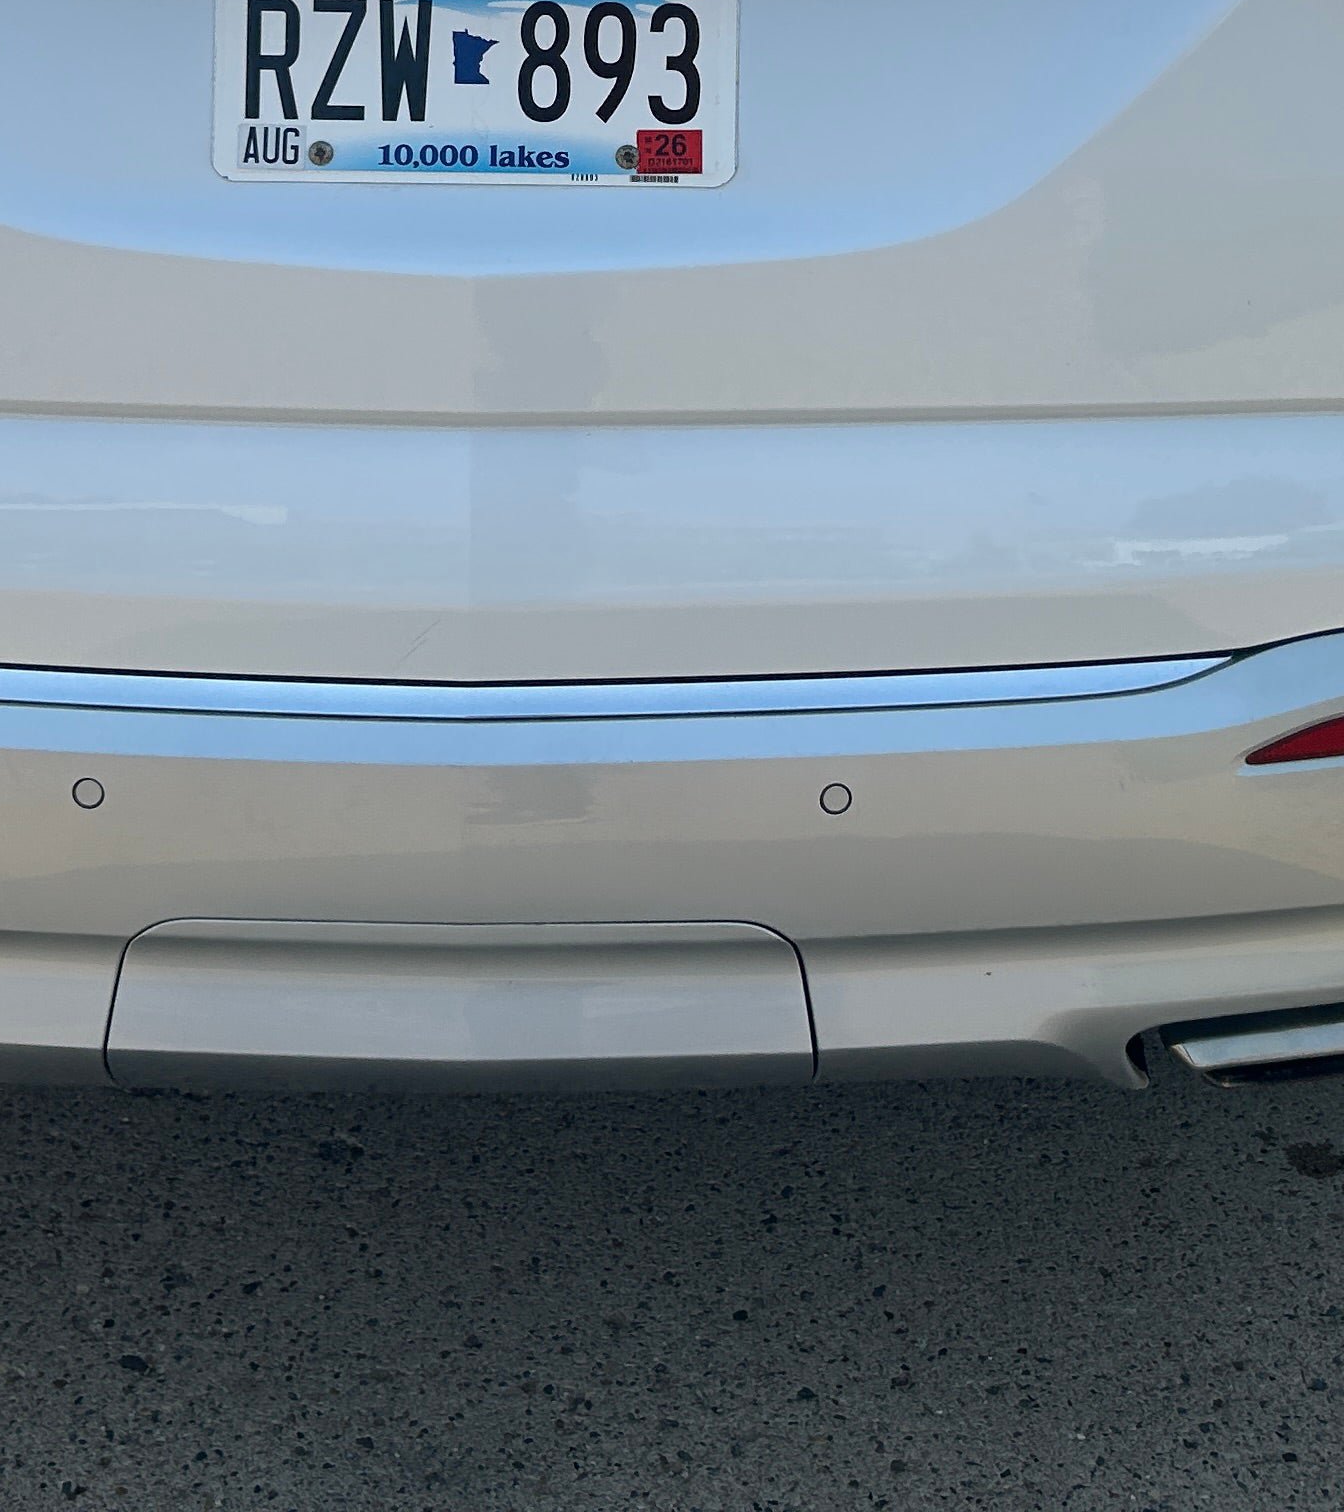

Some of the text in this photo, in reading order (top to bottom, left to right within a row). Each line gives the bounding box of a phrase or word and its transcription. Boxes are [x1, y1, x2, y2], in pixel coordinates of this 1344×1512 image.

[517, 0, 701, 125] 893
[243, 126, 300, 165] AUG
[377, 144, 570, 169] 10,000 lakes
[655, 133, 687, 157] 26
